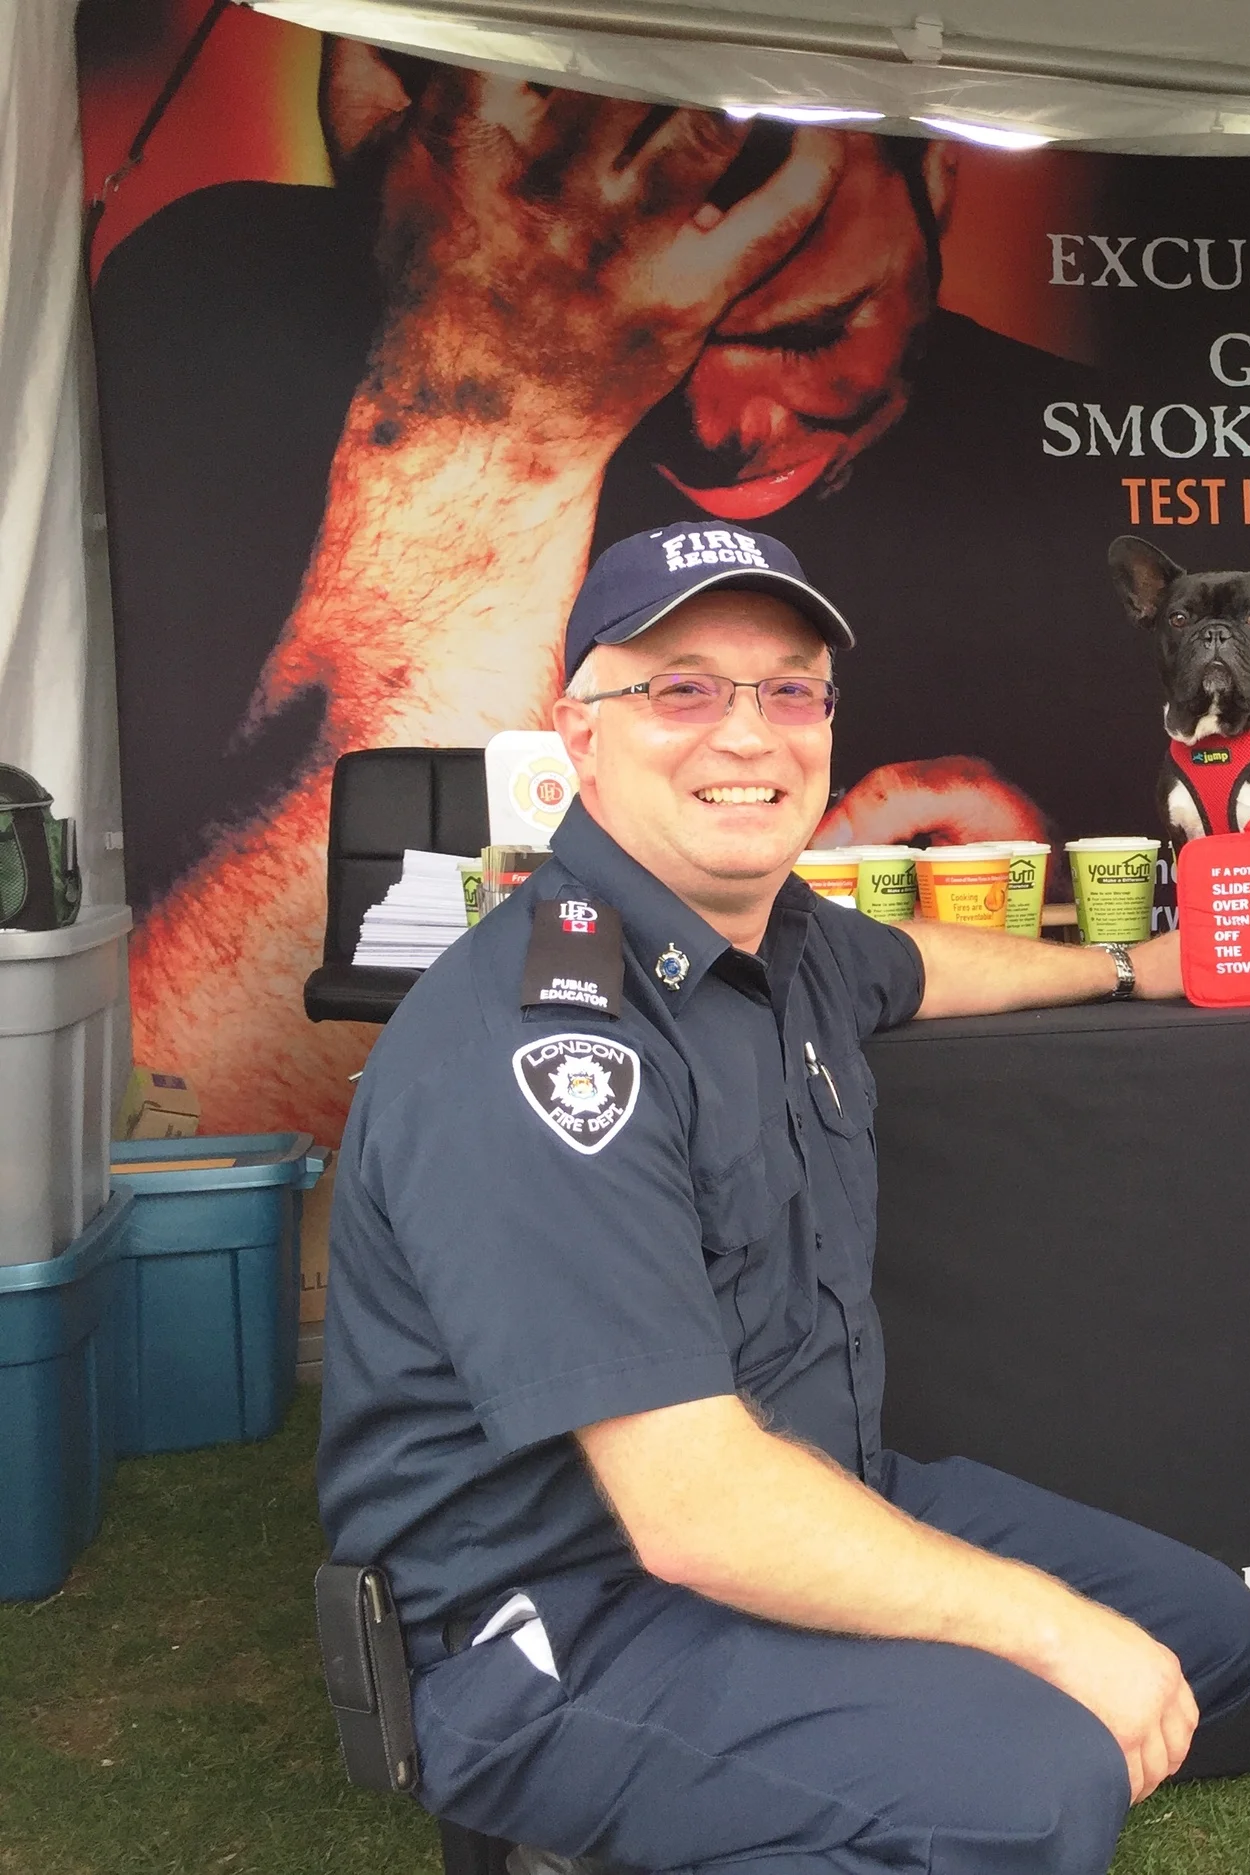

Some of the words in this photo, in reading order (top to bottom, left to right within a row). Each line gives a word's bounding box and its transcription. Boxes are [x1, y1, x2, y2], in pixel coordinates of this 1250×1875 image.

[1122, 477, 1226, 526] TEST
[662, 530, 762, 559] FIRE
[666, 549, 770, 572] RESCUE
[1203, 751, 1229, 763] jump
[511, 874, 529, 882] Fro
[1211, 867, 1221, 877] IF
[1223, 867, 1231, 877] A
[950, 893, 979, 902] Cooking
[953, 903, 971, 911] Fires
[1212, 899, 1249, 912] OVER
[1214, 914, 1250, 927] TURN
[1214, 931, 1240, 942] OFF
[1214, 945, 1242, 958] THE
[552, 978, 598, 994] PUBLIC
[540, 989, 608, 1008] EDUCATOR
[527, 1040, 625, 1067] LONDON
[549, 1106, 583, 1132] FIRE
